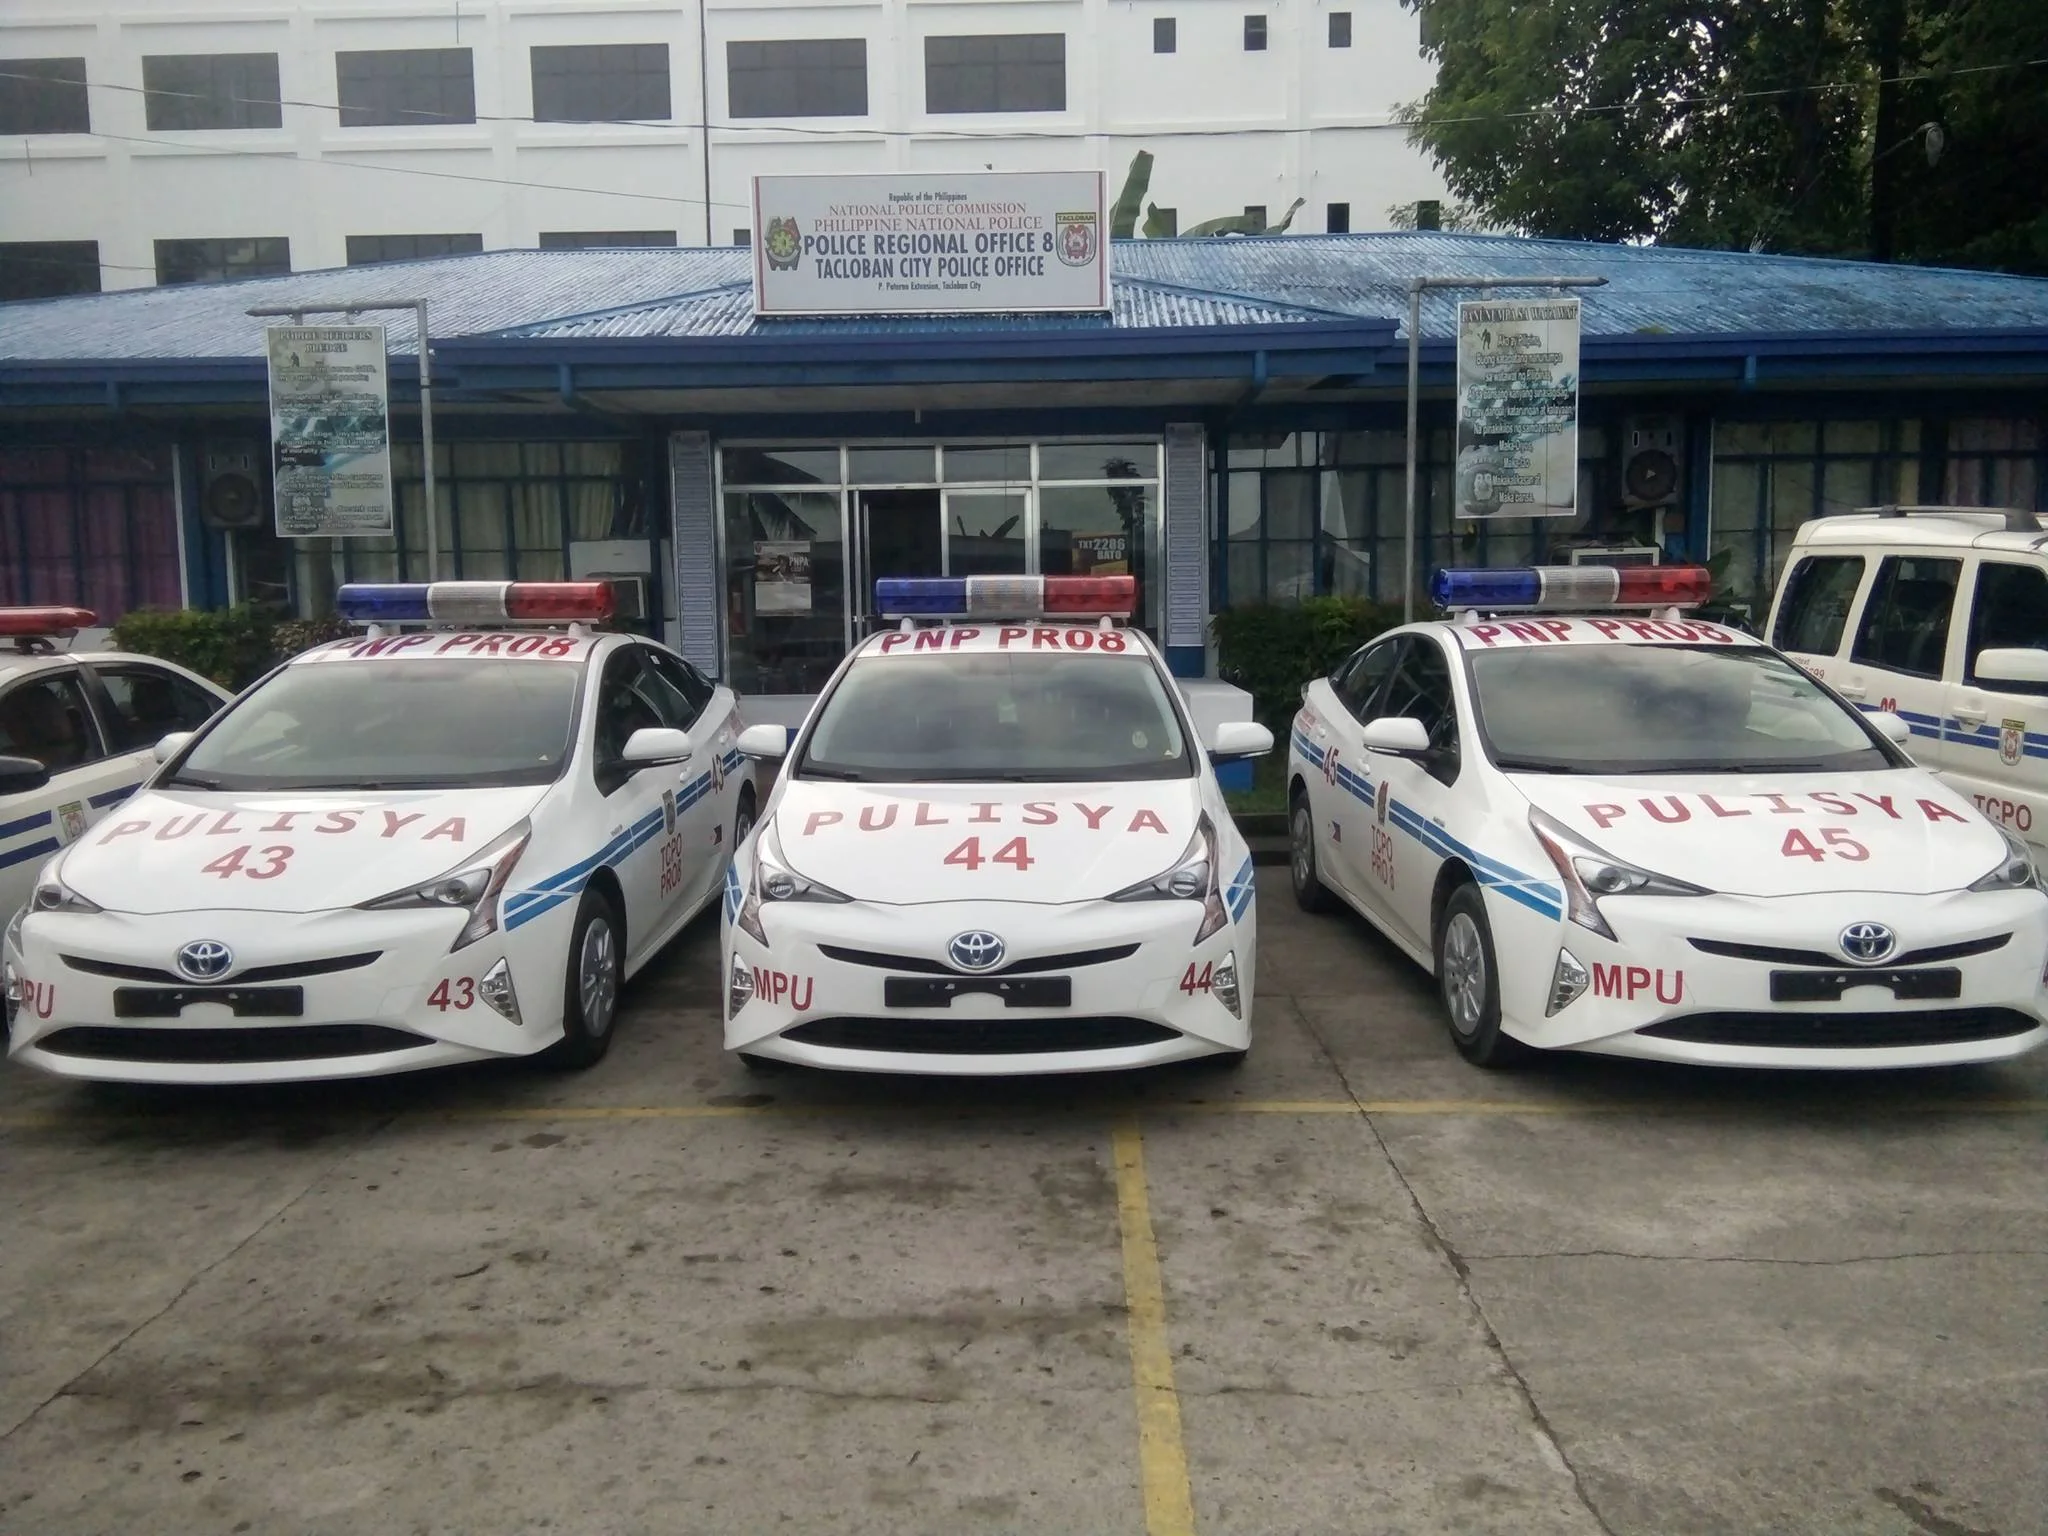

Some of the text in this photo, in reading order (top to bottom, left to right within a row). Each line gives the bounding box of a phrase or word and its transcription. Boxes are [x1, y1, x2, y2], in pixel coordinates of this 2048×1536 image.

[829, 202, 1027, 216] NATIONAL POLICE COMMISSION
[889, 191, 967, 203] Republic of the Philippines
[814, 216, 1043, 232] PHILIPPINE NATIONAL POLICE
[804, 231, 1053, 255] POLICE REGIONAL OFFICE 8
[815, 255, 1044, 279] TACLOBAN CITY POLICE OFFICE
[943, 281, 968, 290] Tacloban
[969, 280, 981, 291] City
[335, 633, 580, 659] PNP PRO8
[879, 627, 1127, 655] PNP PRO8
[1465, 618, 1734, 648] PNP PRO8
[712, 754, 725, 795] 43
[1323, 745, 1339, 786] 45
[96, 810, 467, 846] PULISYA
[802, 802, 1170, 836] PULISYA
[1583, 792, 1970, 829] PULISYA
[1973, 793, 2033, 832] TCPO
[660, 832, 682, 872] TCPO
[943, 836, 1036, 871] 44
[1371, 824, 1393, 863] TCPO
[1781, 827, 1871, 863] 45
[200, 845, 295, 880] 43
[660, 859, 682, 900] PRO8
[428, 977, 475, 1013] 43
[753, 966, 814, 1011] MPU
[1180, 961, 1213, 996] 44
[1592, 962, 1685, 1005] MPU
